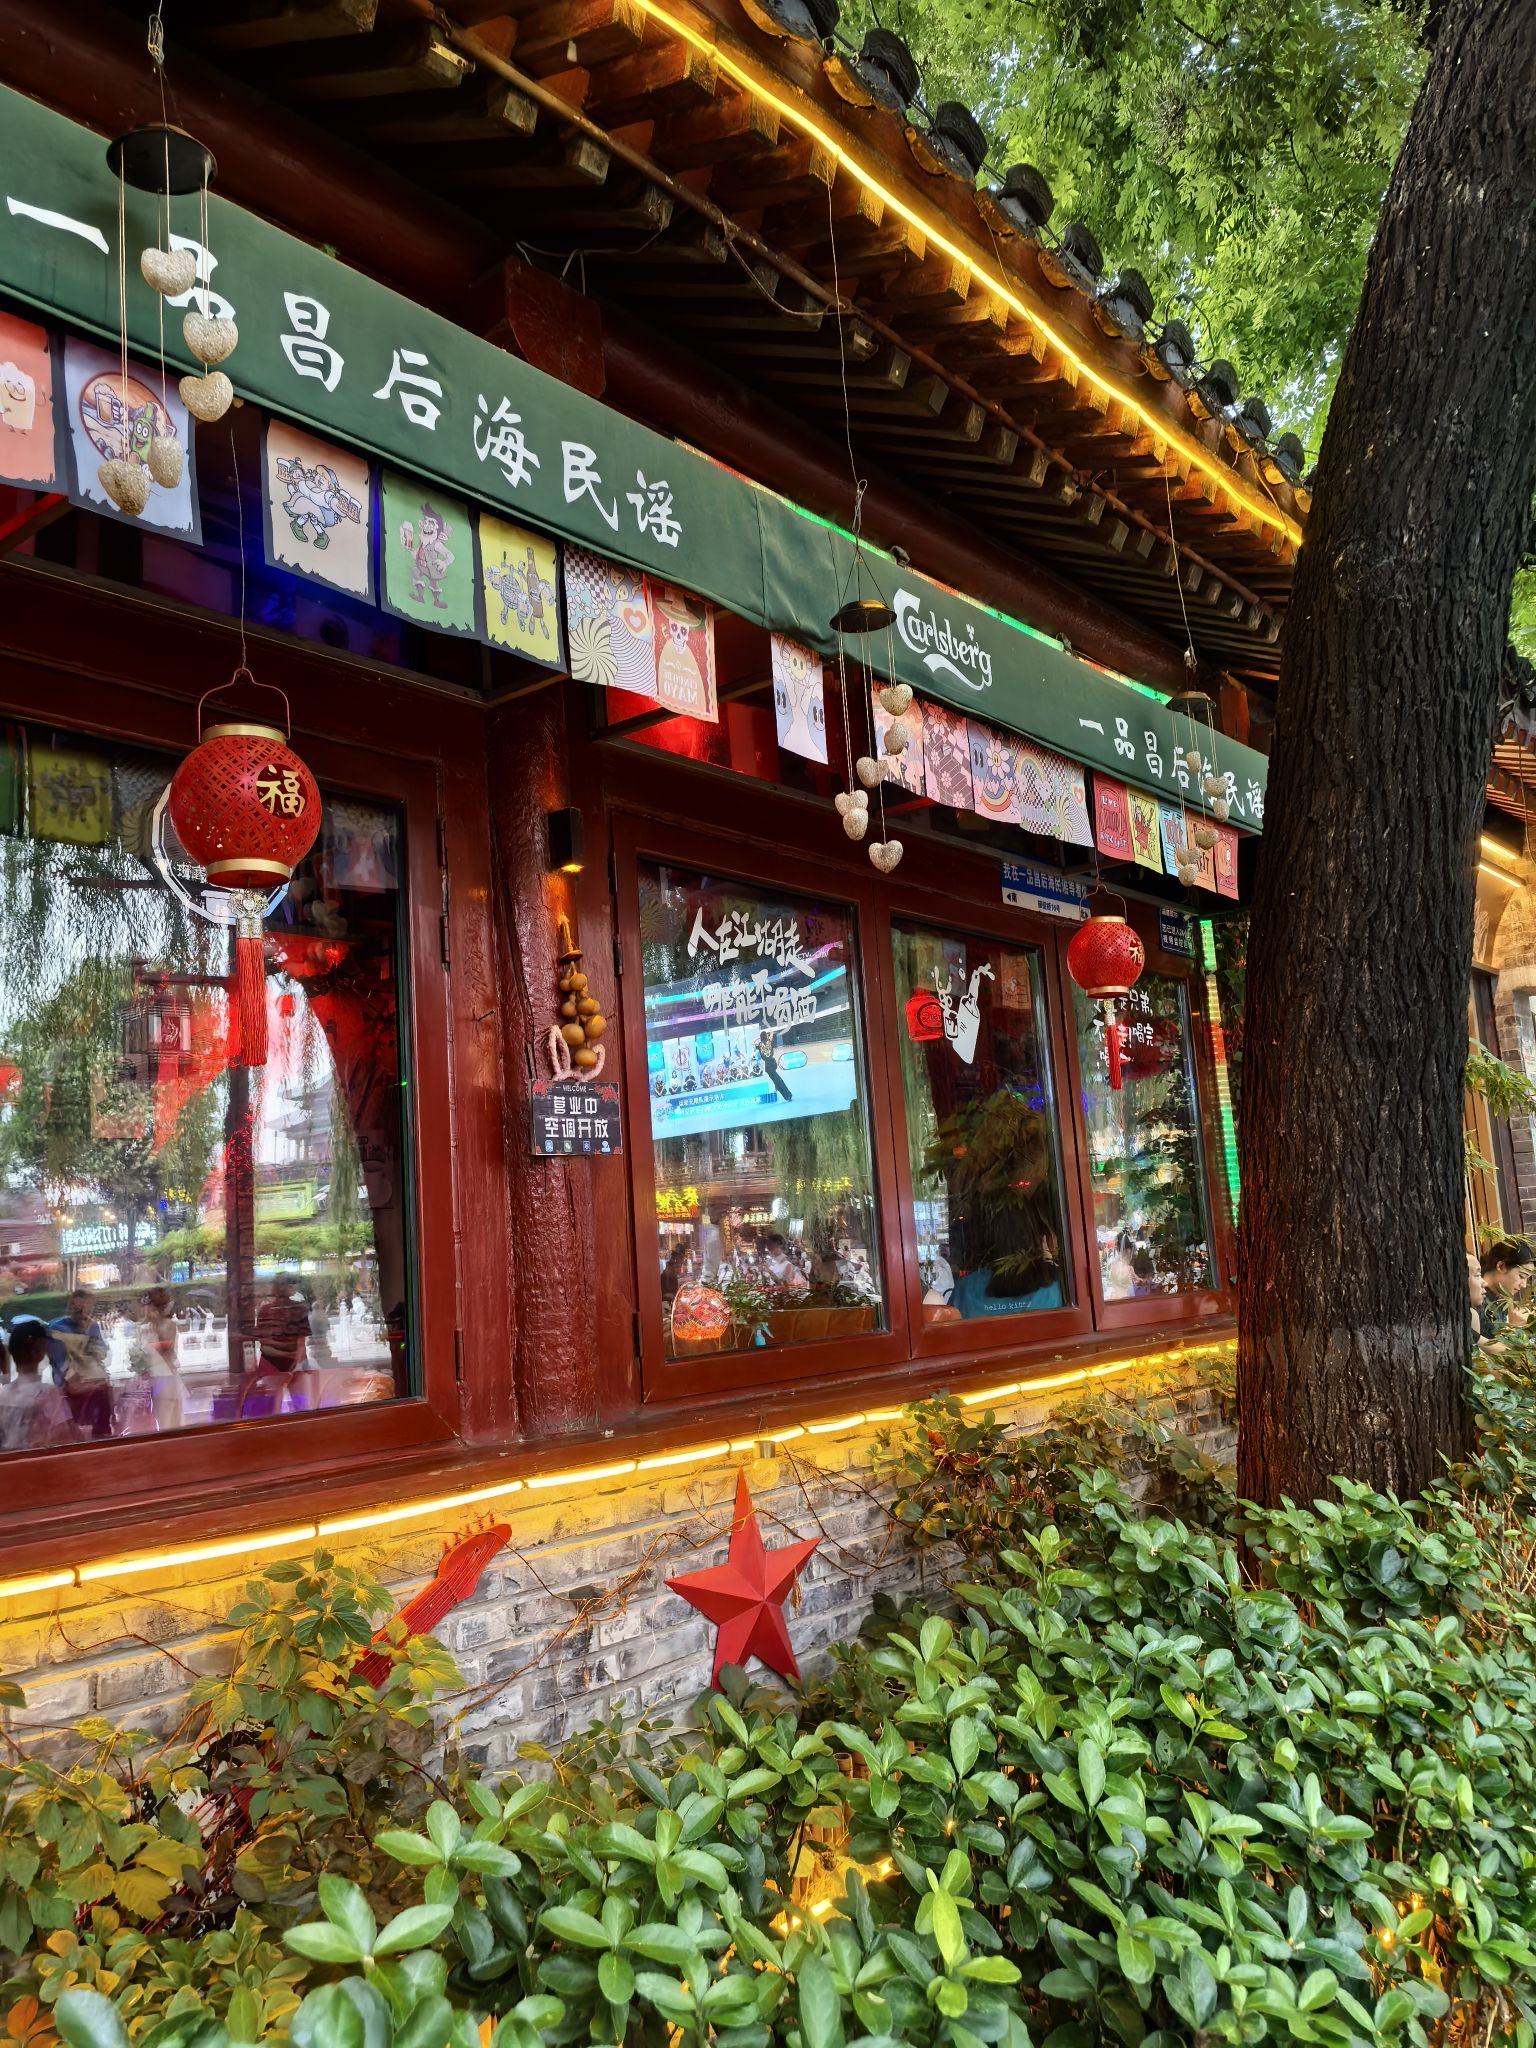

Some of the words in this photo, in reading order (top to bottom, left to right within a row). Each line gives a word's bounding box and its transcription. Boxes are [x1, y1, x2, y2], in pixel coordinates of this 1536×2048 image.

[893, 587, 993, 691] Carlsberg
[255, 764, 306, 818] 福
[687, 907, 816, 978] 人在江湖走
[700, 968, 818, 1036] 哪能不喝酒
[553, 1095, 598, 1115] 营业中
[562, 1084, 587, 1093] WELCOME
[544, 1117, 609, 1139] 空调开放
[984, 1302, 1006, 1311] hello
